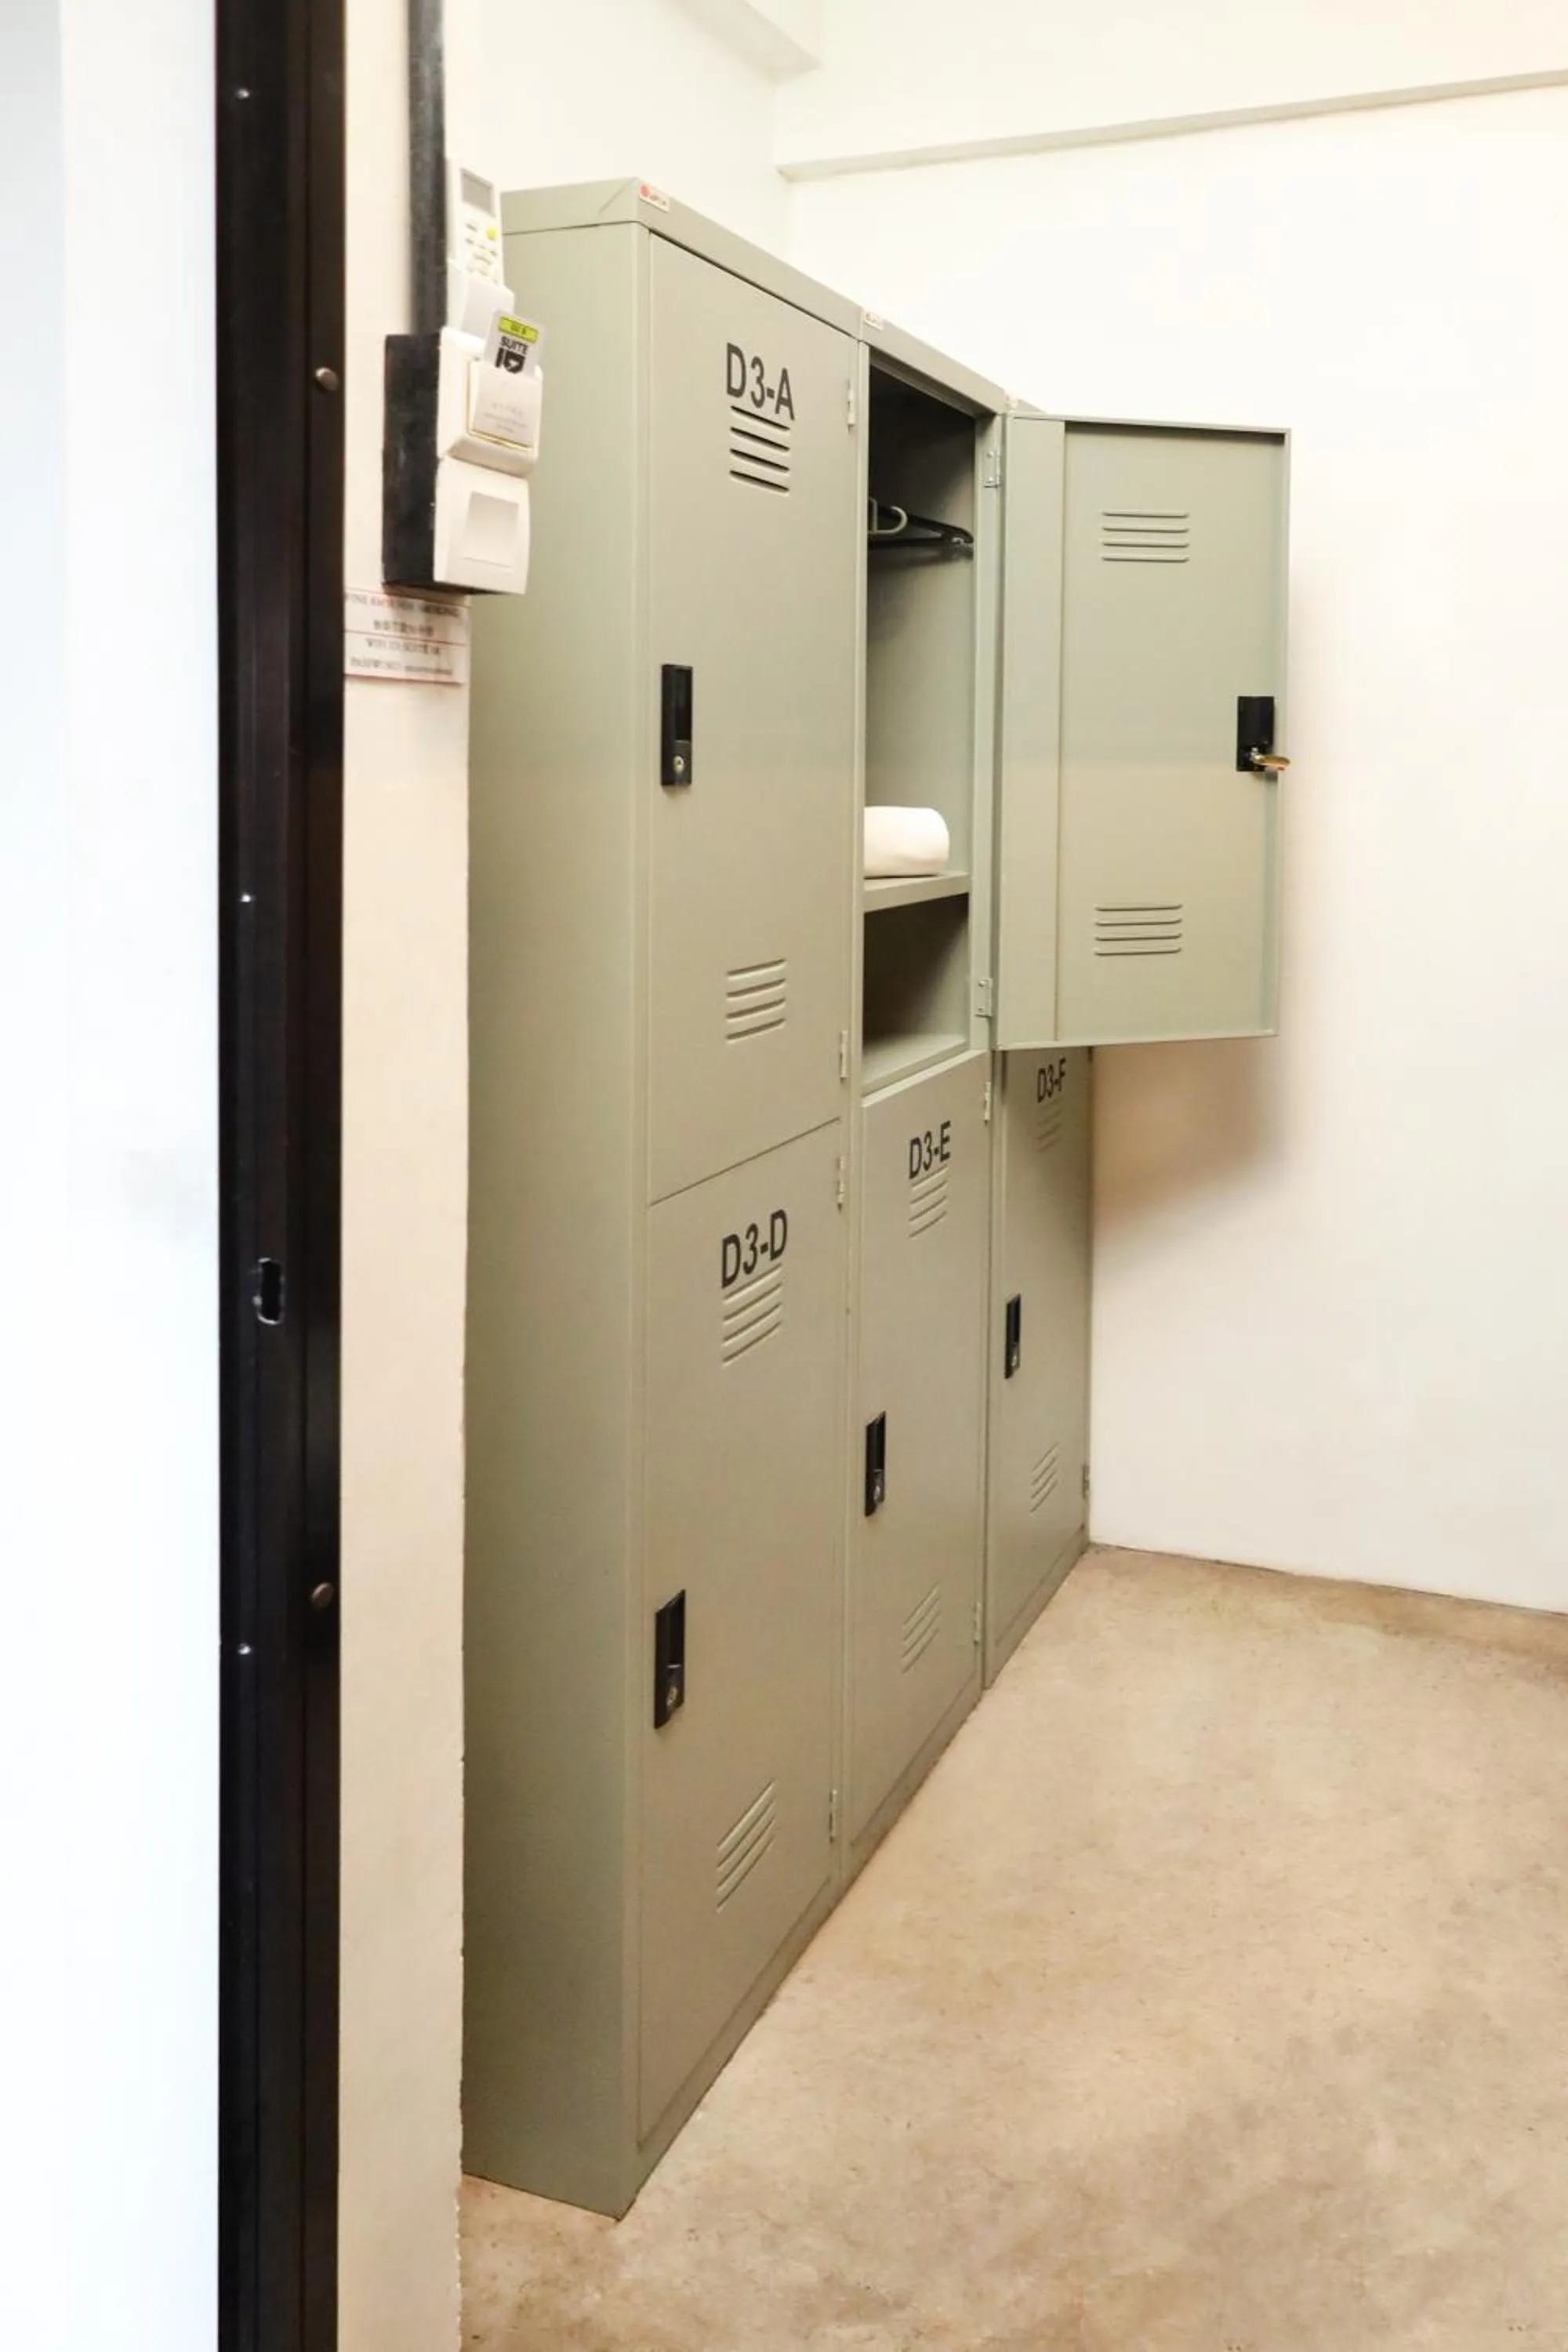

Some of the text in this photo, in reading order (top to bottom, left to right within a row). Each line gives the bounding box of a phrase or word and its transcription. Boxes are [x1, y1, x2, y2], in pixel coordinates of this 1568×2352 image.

[501, 336, 528, 355] SUITE
[727, 342, 795, 420] D3-A
[1037, 1057, 1066, 1104] D3-F
[909, 1119, 951, 1180] D3-E
[721, 1208, 788, 1290] D3-D
